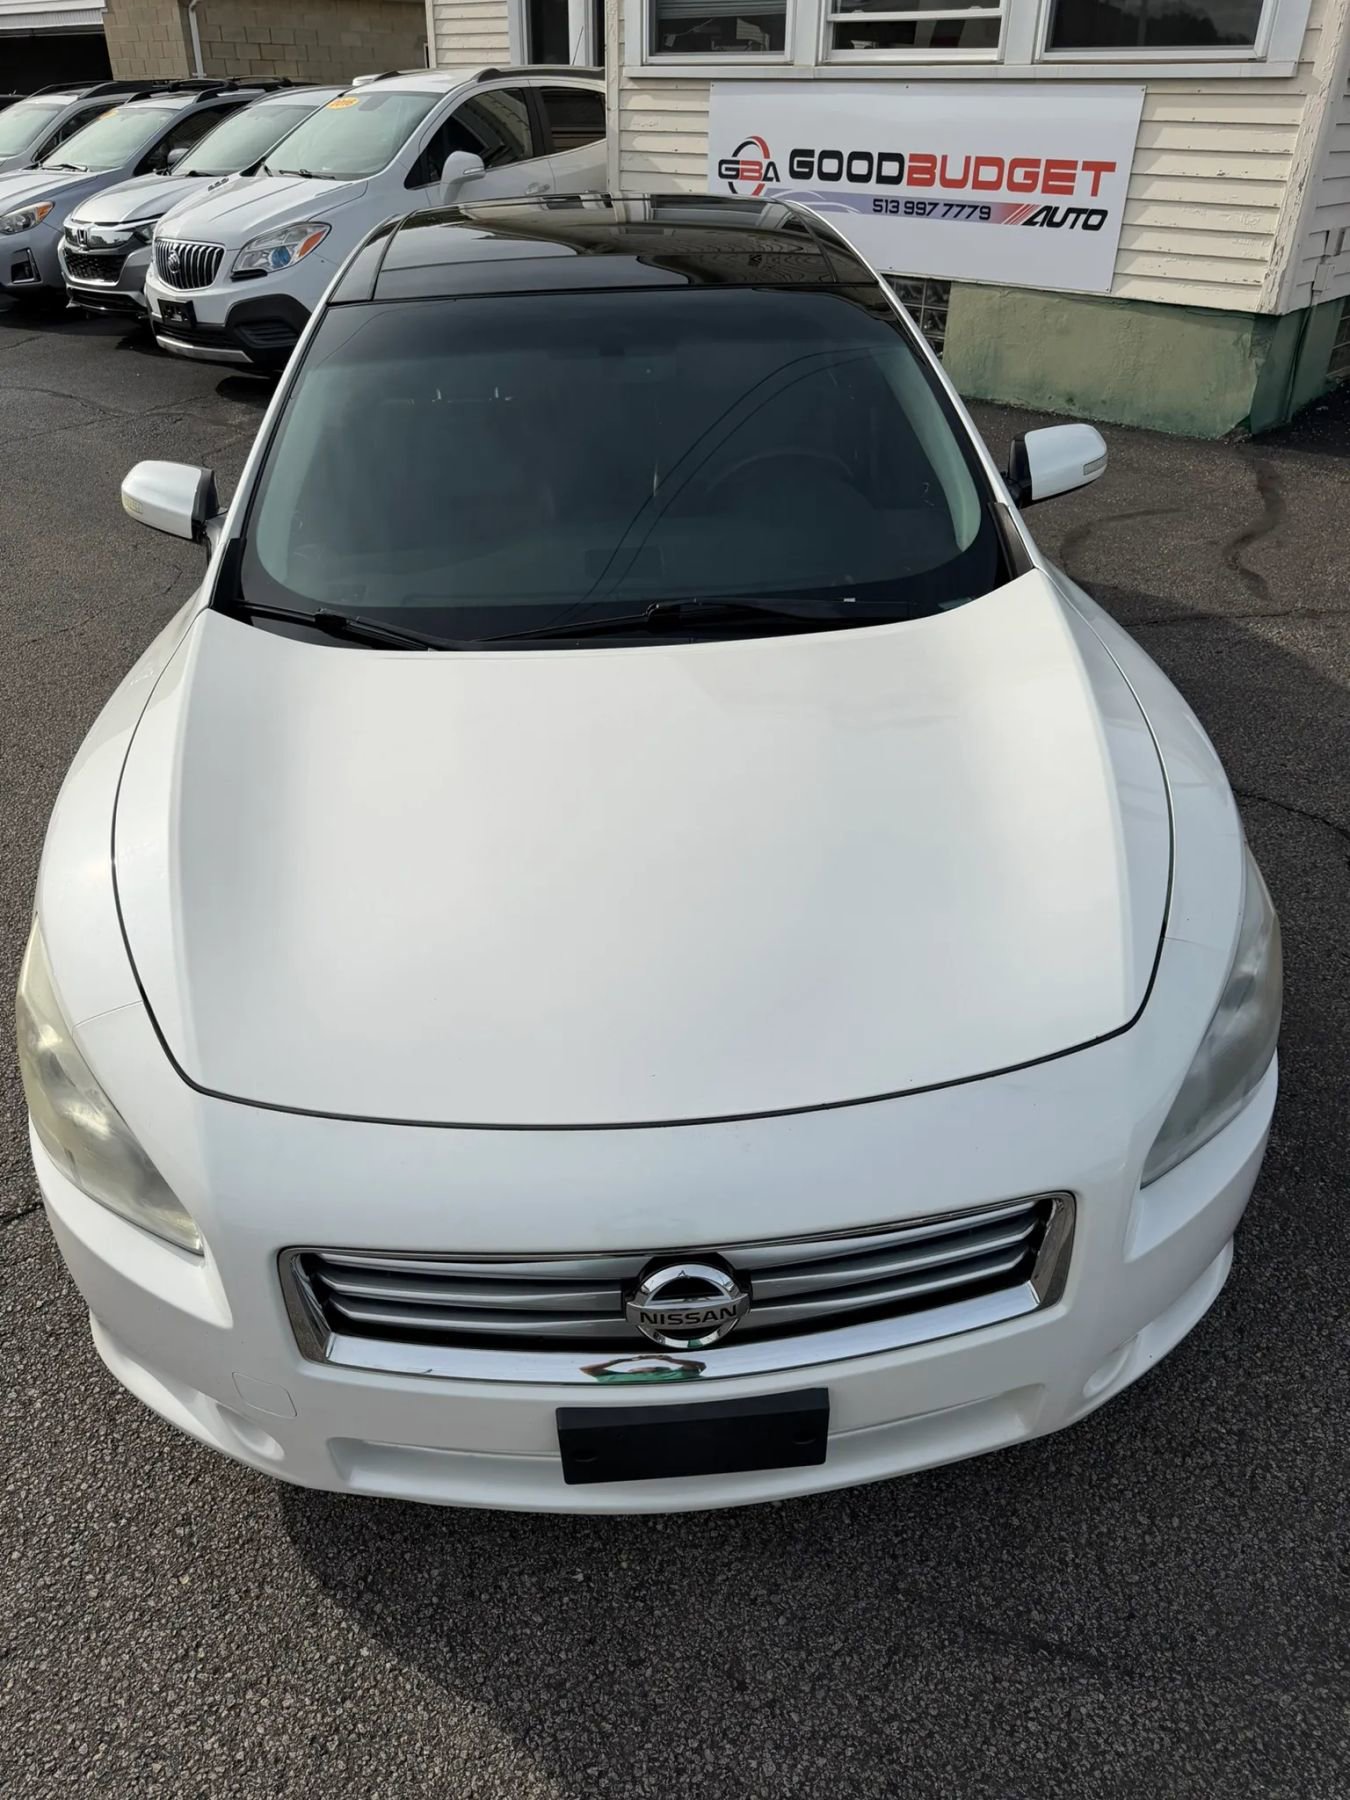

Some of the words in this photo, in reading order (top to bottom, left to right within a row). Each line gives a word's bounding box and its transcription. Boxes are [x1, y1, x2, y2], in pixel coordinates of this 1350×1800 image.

[718, 158, 781, 183] GBA
[872, 198, 900, 214] 513
[903, 200, 940, 217] 997
[941, 202, 992, 221] 7779
[1021, 204, 1109, 232] AUTO
[639, 1304, 738, 1326] NISSAN
